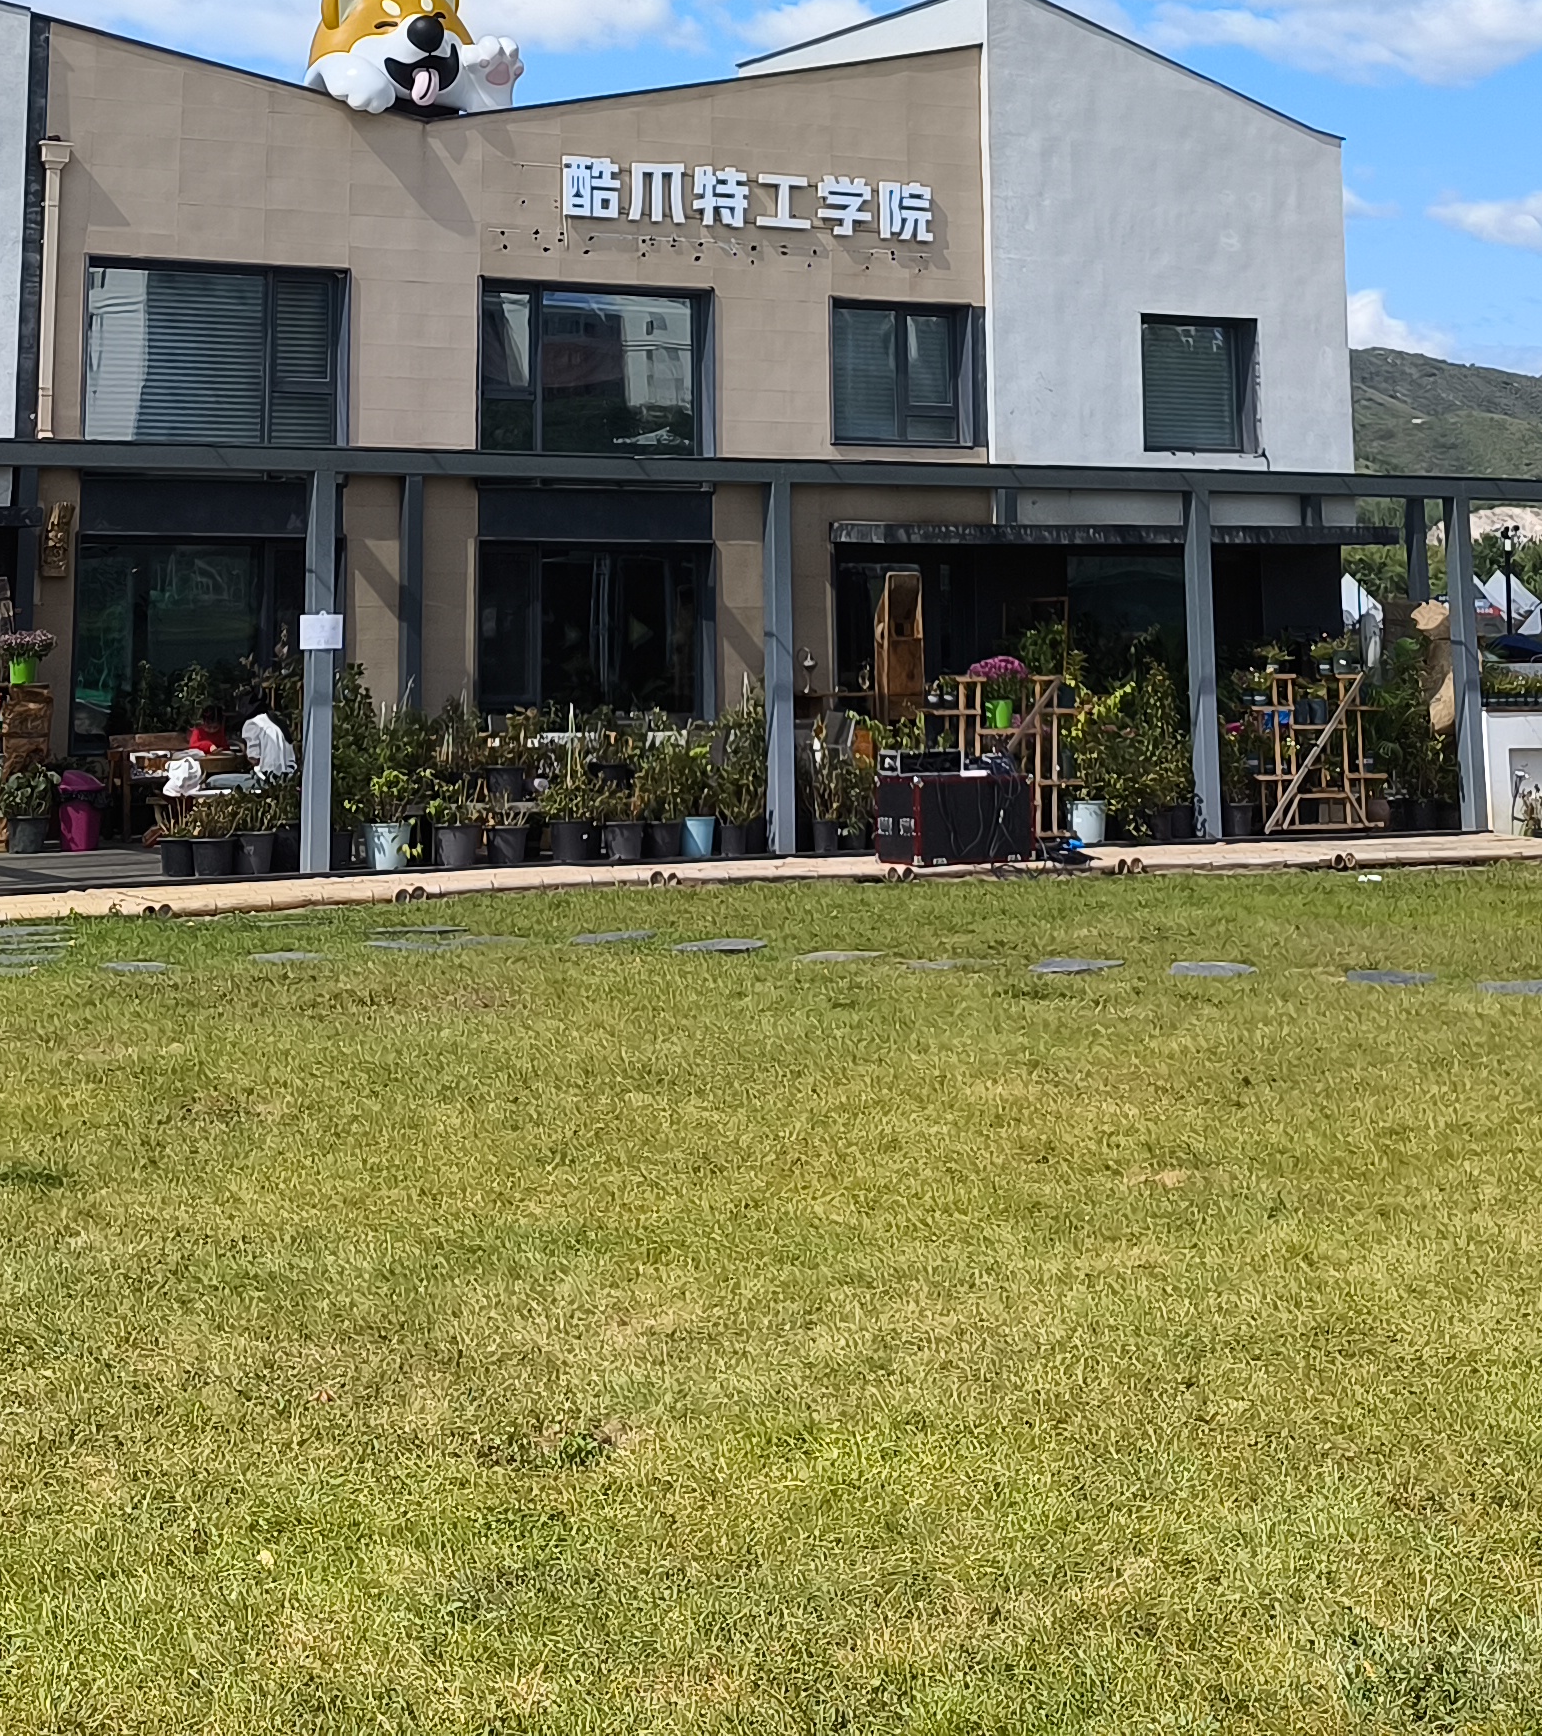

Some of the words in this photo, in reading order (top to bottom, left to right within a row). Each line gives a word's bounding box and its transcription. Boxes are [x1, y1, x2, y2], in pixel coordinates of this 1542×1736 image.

[562, 155, 934, 242] 酷爪特工学院
